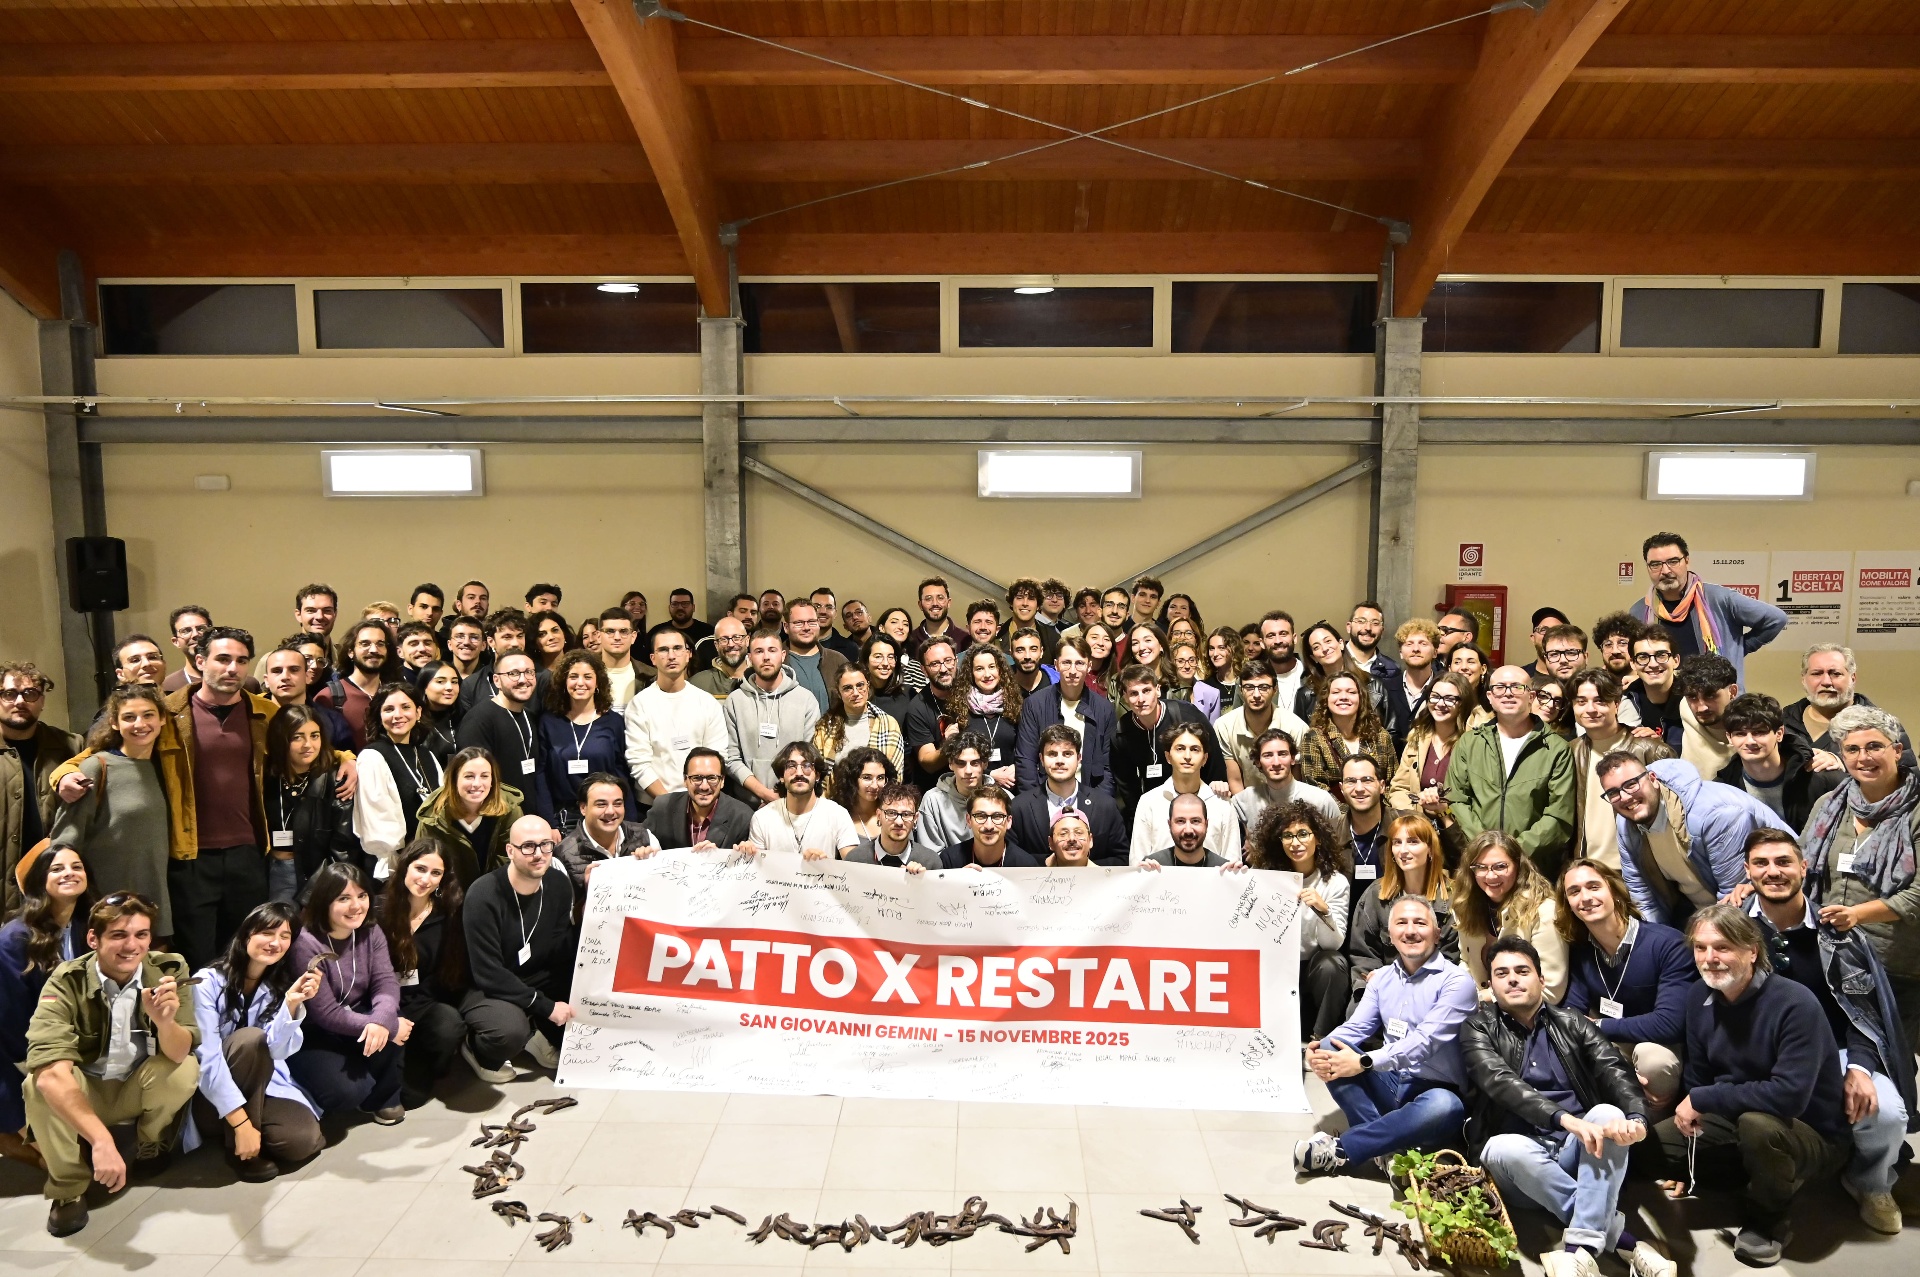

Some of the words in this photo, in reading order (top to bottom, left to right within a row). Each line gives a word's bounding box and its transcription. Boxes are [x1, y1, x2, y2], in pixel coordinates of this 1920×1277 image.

[1861, 569, 1910, 580] MOBILITÀ
[1776, 579, 1793, 602] 1
[1793, 582, 1842, 592] SCELTA
[646, 932, 858, 999] PATTO
[870, 950, 921, 1005] X
[936, 954, 1230, 1015] RESTARE
[739, 1013, 777, 1030] SAN
[780, 1016, 872, 1038] GIOVANNI
[875, 1024, 938, 1042] GEMINI
[957, 1029, 976, 1043] 15
[980, 1030, 1082, 1045] NOVEMBRE
[1085, 1031, 1130, 1046] 2025
